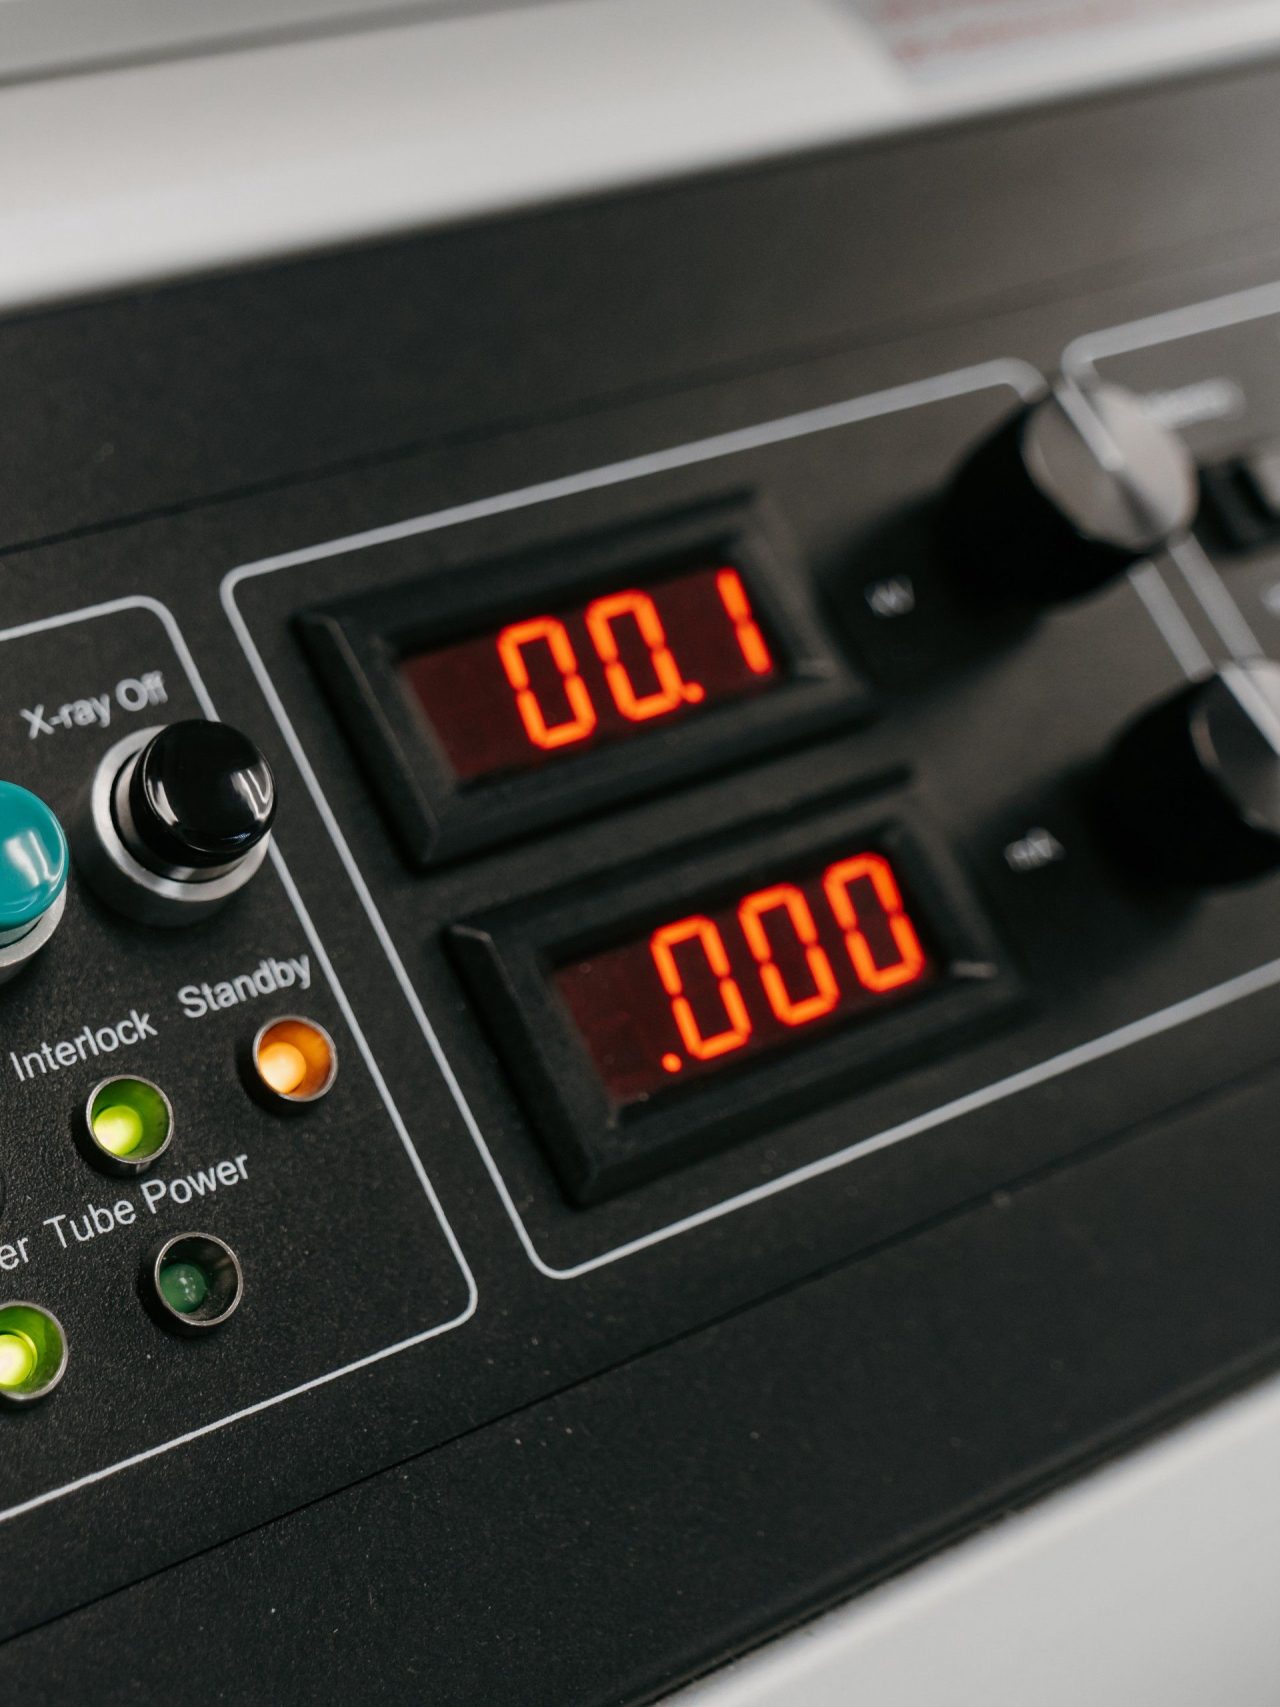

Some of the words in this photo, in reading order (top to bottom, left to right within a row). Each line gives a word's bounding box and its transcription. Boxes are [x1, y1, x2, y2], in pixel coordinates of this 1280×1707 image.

[498, 567, 771, 749] 00.1
[20, 692, 112, 738] X-ray
[116, 671, 169, 711] Off
[177, 955, 312, 1019] Standby
[9, 1010, 158, 1082] Interlock
[43, 1200, 136, 1248] Tube
[141, 1152, 250, 1214] Power
